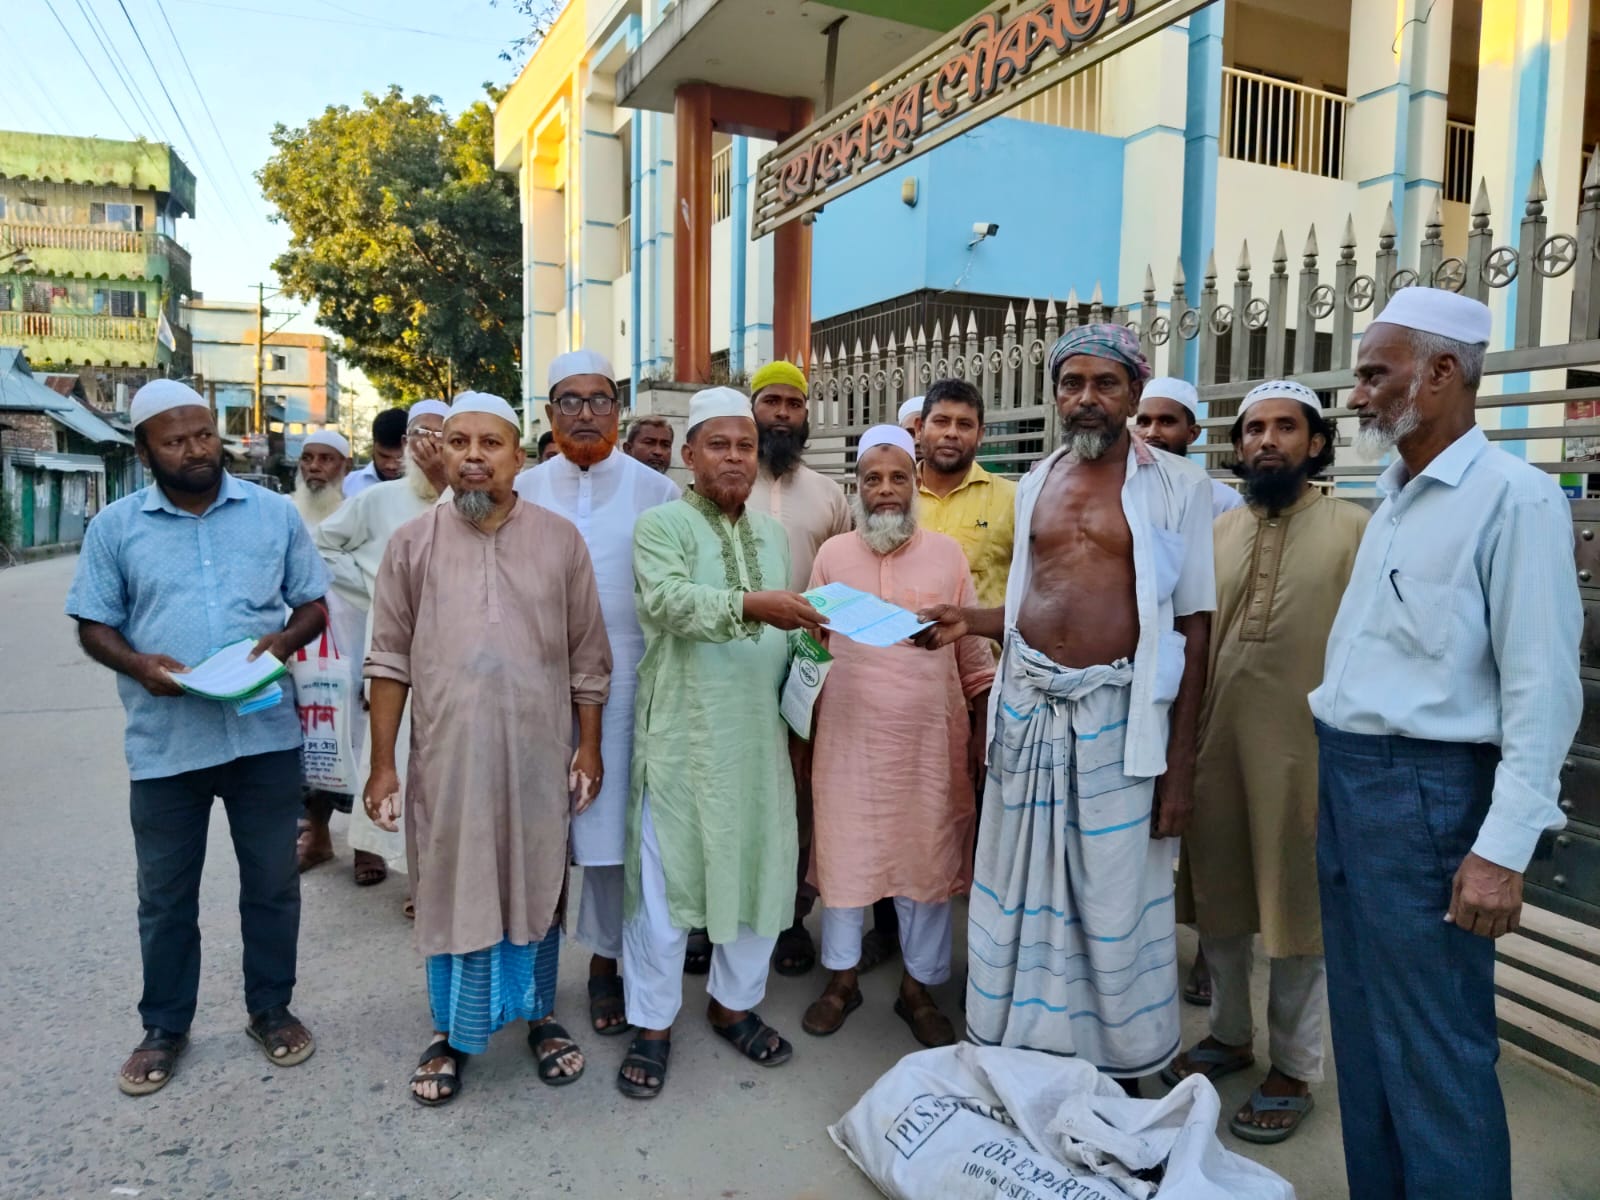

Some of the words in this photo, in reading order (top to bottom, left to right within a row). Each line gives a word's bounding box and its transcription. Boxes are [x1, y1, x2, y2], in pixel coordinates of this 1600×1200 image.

[776, 79, 928, 206] হোসেনপুর
[962, 1161, 998, 1186] 100%
[998, 1176, 1043, 1200] USTE
